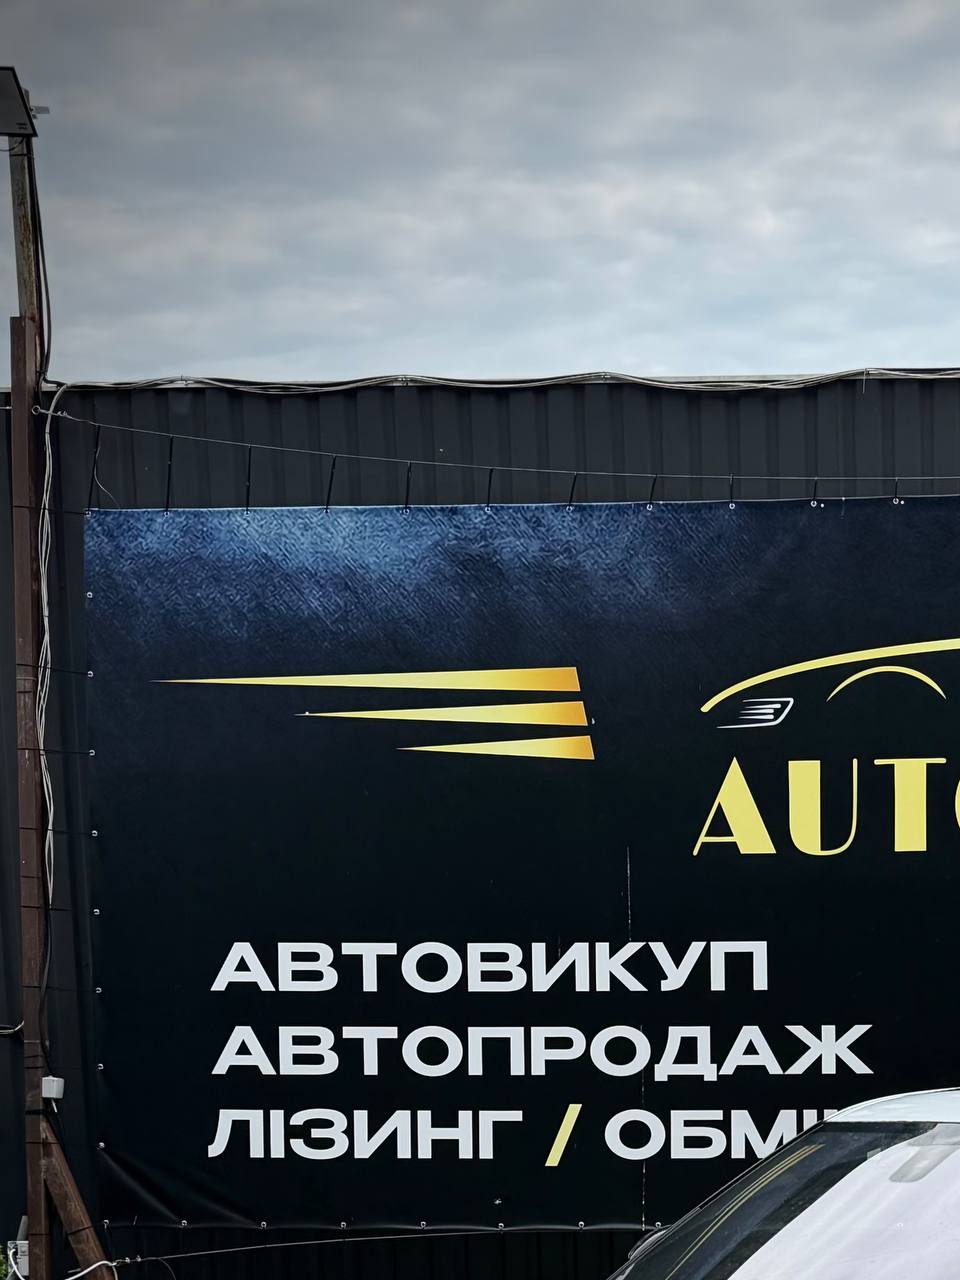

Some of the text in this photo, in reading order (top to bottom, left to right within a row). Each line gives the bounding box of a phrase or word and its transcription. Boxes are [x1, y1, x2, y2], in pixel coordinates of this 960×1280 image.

[210, 941, 768, 994] АВТОВИКУП
[211, 1025, 874, 1082] АВТОПРОДАЖ
[207, 1109, 523, 1159] ЛІЗИНГ
[604, 1109, 838, 1160] ОБМ
